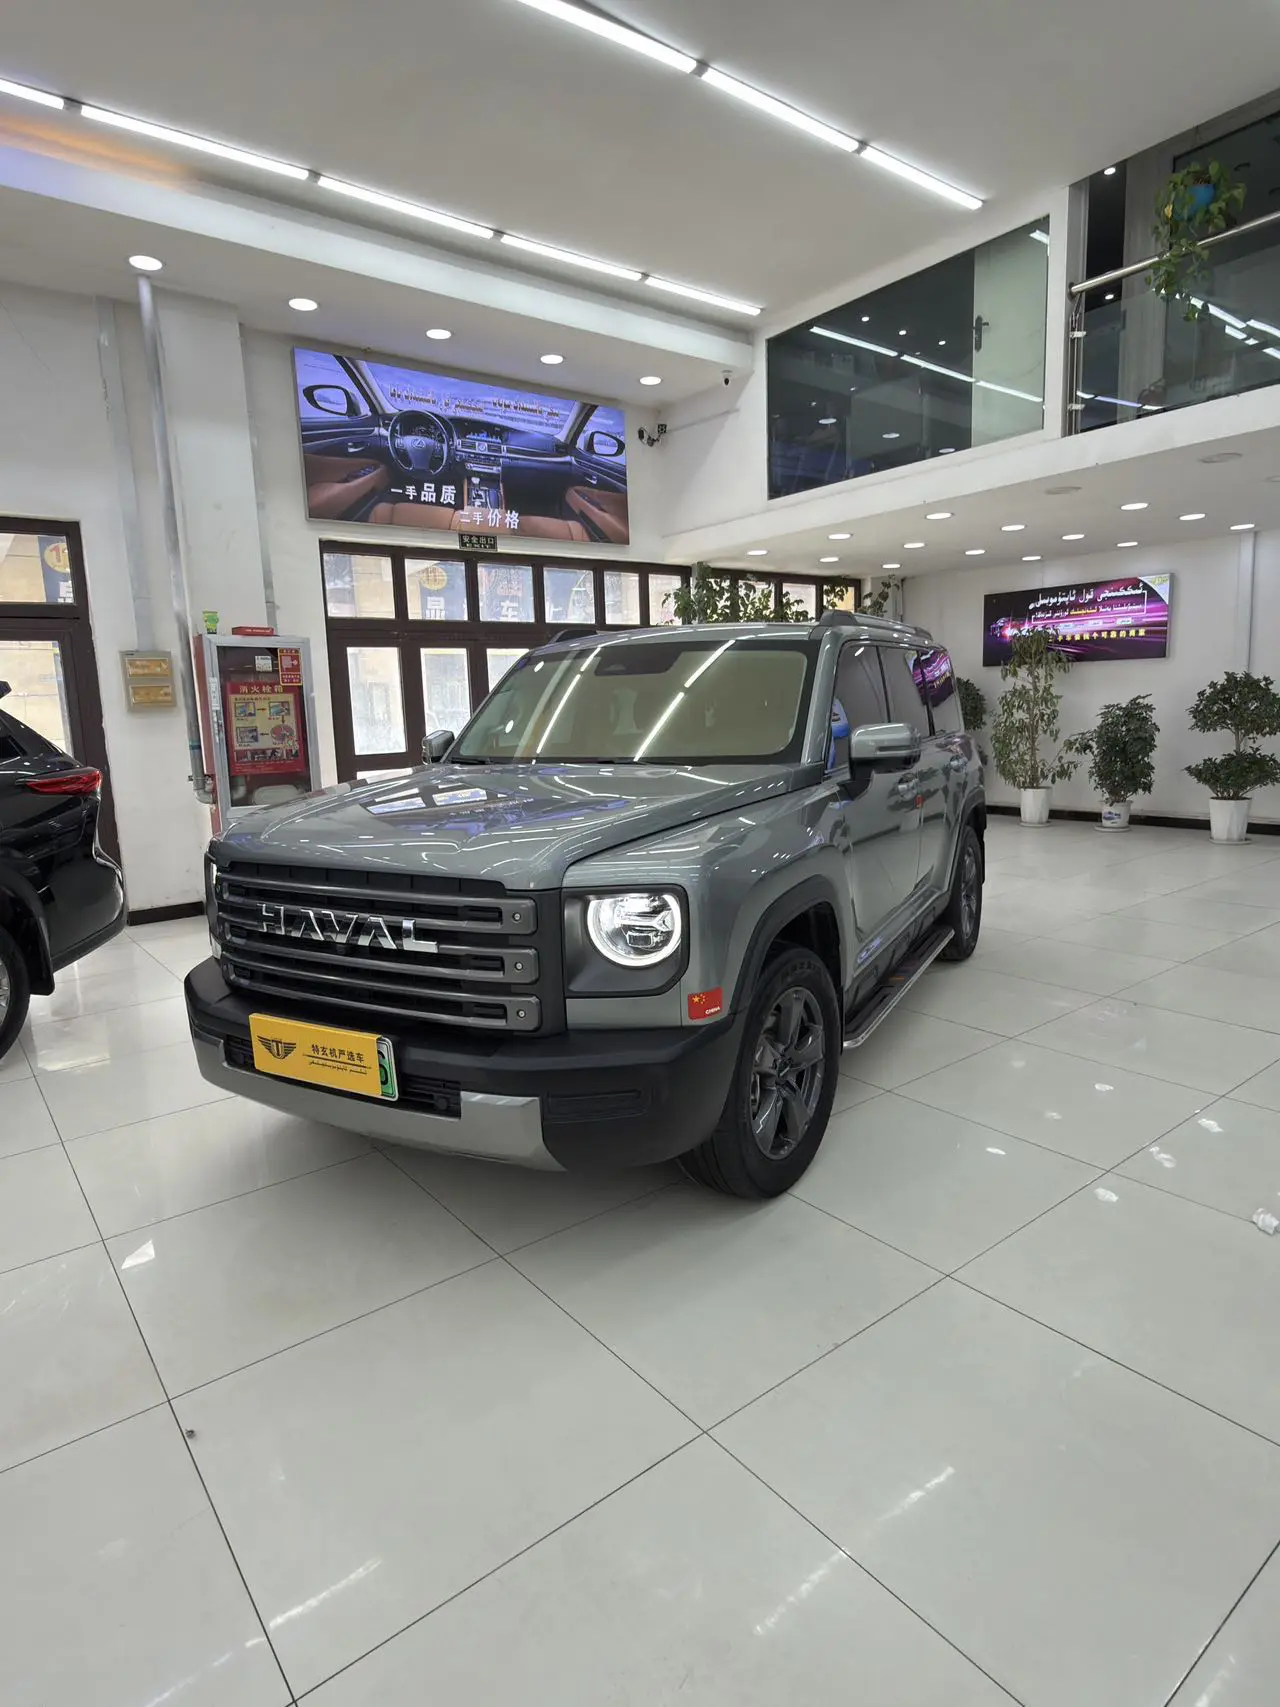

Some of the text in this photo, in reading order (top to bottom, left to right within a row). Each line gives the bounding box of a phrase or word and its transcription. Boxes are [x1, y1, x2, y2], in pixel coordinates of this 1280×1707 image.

[391, 483, 457, 506] 一手品质
[460, 509, 520, 530] 二手价格
[462, 535, 494, 545] 安全出口
[256, 903, 439, 953] HAVAL
[705, 1006, 721, 1015] CHINA
